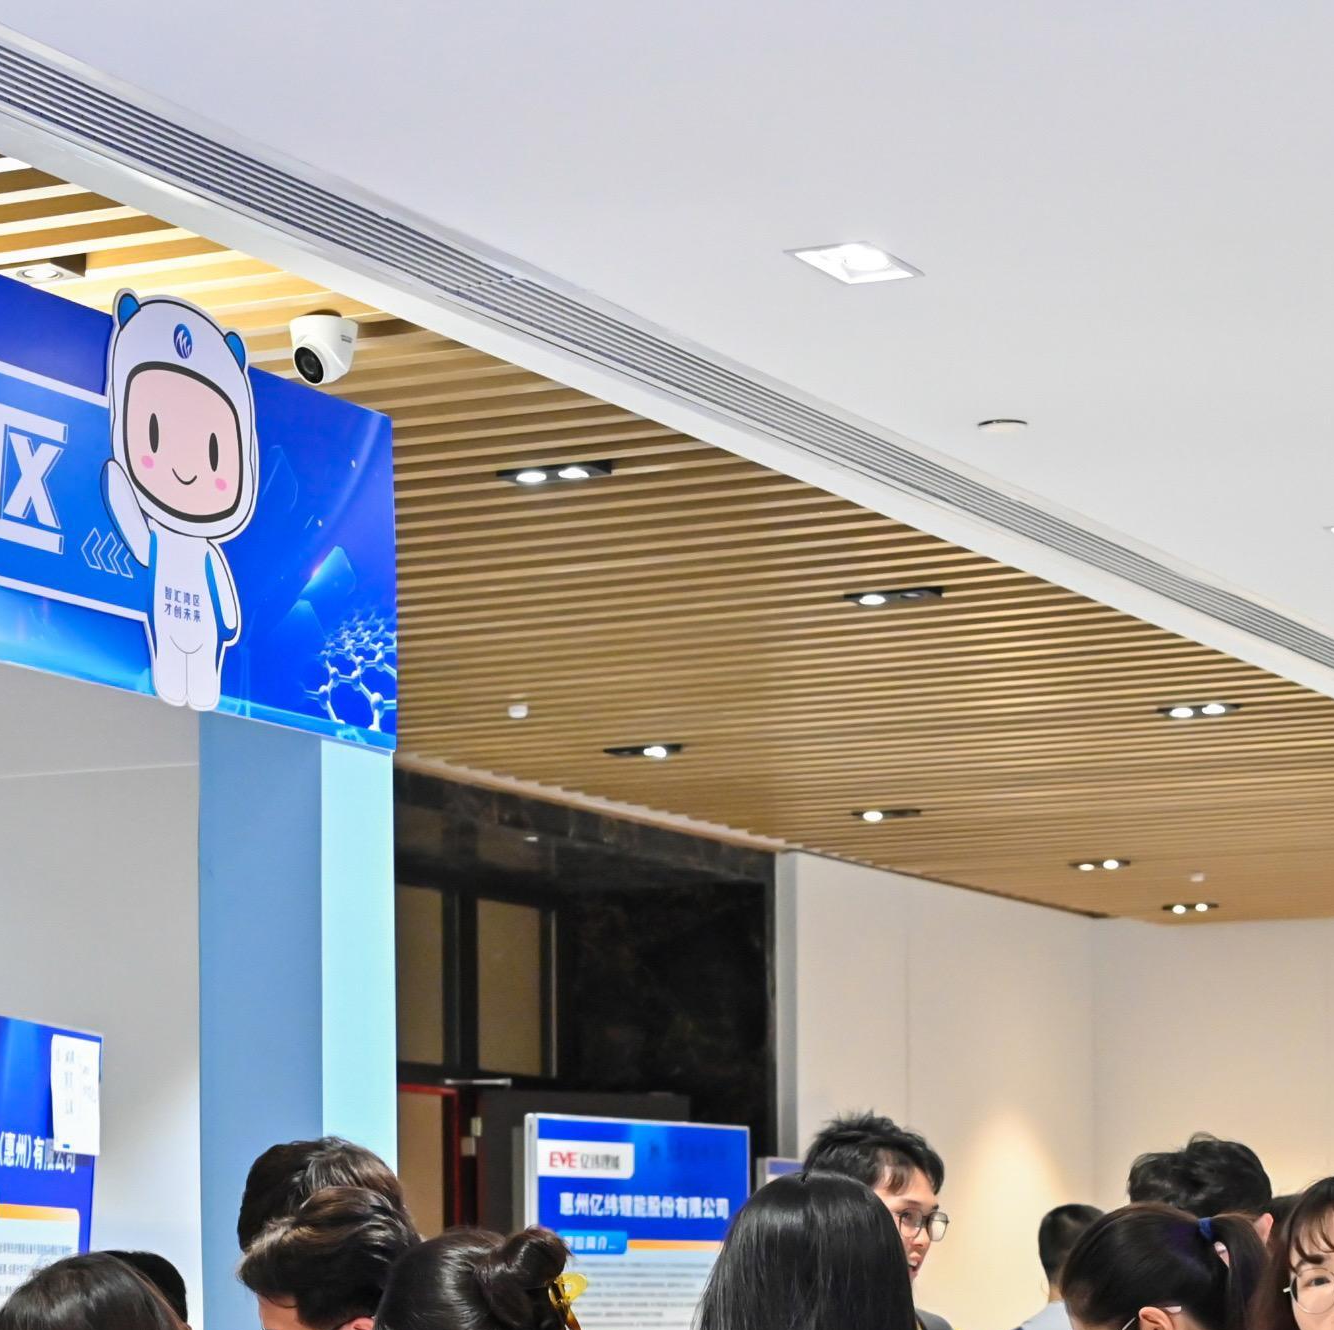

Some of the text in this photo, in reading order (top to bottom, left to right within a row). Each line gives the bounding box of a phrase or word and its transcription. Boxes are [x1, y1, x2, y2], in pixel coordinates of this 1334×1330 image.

[164, 586, 200, 607] 智汇湾区
[164, 603, 201, 623] 才创未来
[549, 1151, 577, 1168] EVE
